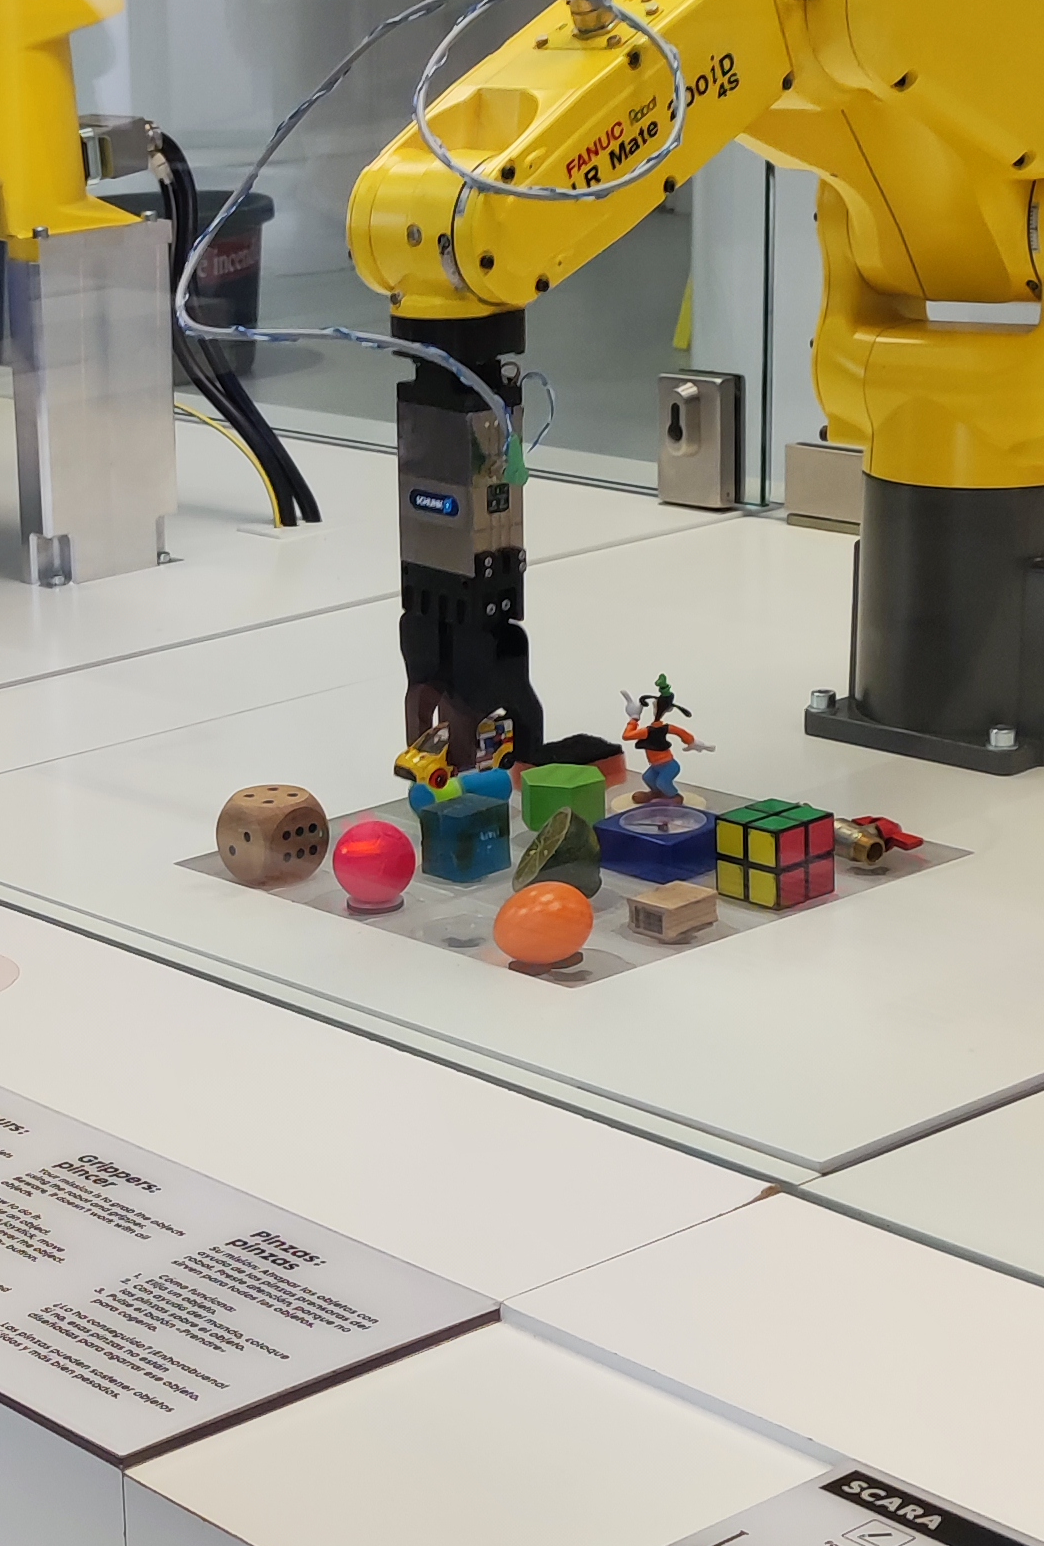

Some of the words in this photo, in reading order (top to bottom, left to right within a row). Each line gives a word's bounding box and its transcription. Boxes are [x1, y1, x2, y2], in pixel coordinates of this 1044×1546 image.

[717, 72, 740, 100] 4S
[565, 120, 625, 179] FANUC
[608, 120, 659, 171] Mate
[49, 1160, 120, 1189] pincer
[76, 1153, 163, 1195] Grippers:
[223, 1237, 301, 1272] pinzas
[248, 1229, 328, 1268] Pinzas:
[841, 1480, 942, 1531] SCARA
